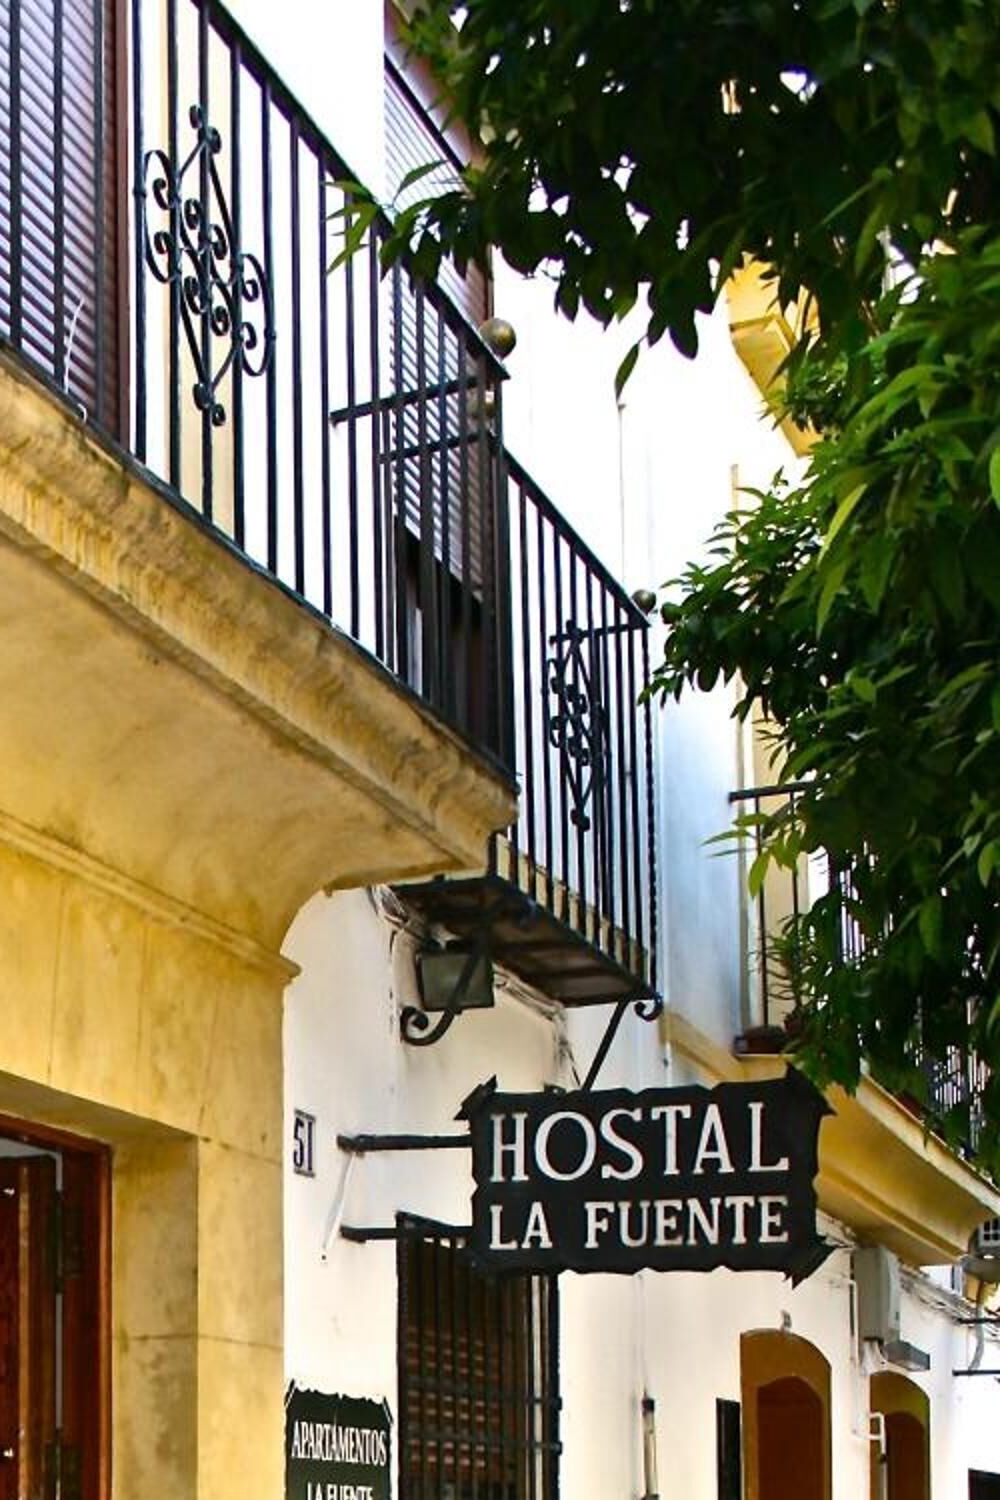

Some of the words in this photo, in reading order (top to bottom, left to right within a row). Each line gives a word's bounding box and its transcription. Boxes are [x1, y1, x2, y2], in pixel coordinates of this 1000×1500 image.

[293, 1117, 313, 1171] 51
[489, 1101, 790, 1182] HOSTAL
[489, 1201, 553, 1250] LA
[584, 1195, 789, 1249] FUENTE
[291, 1419, 387, 1467] APARTAMENTOS
